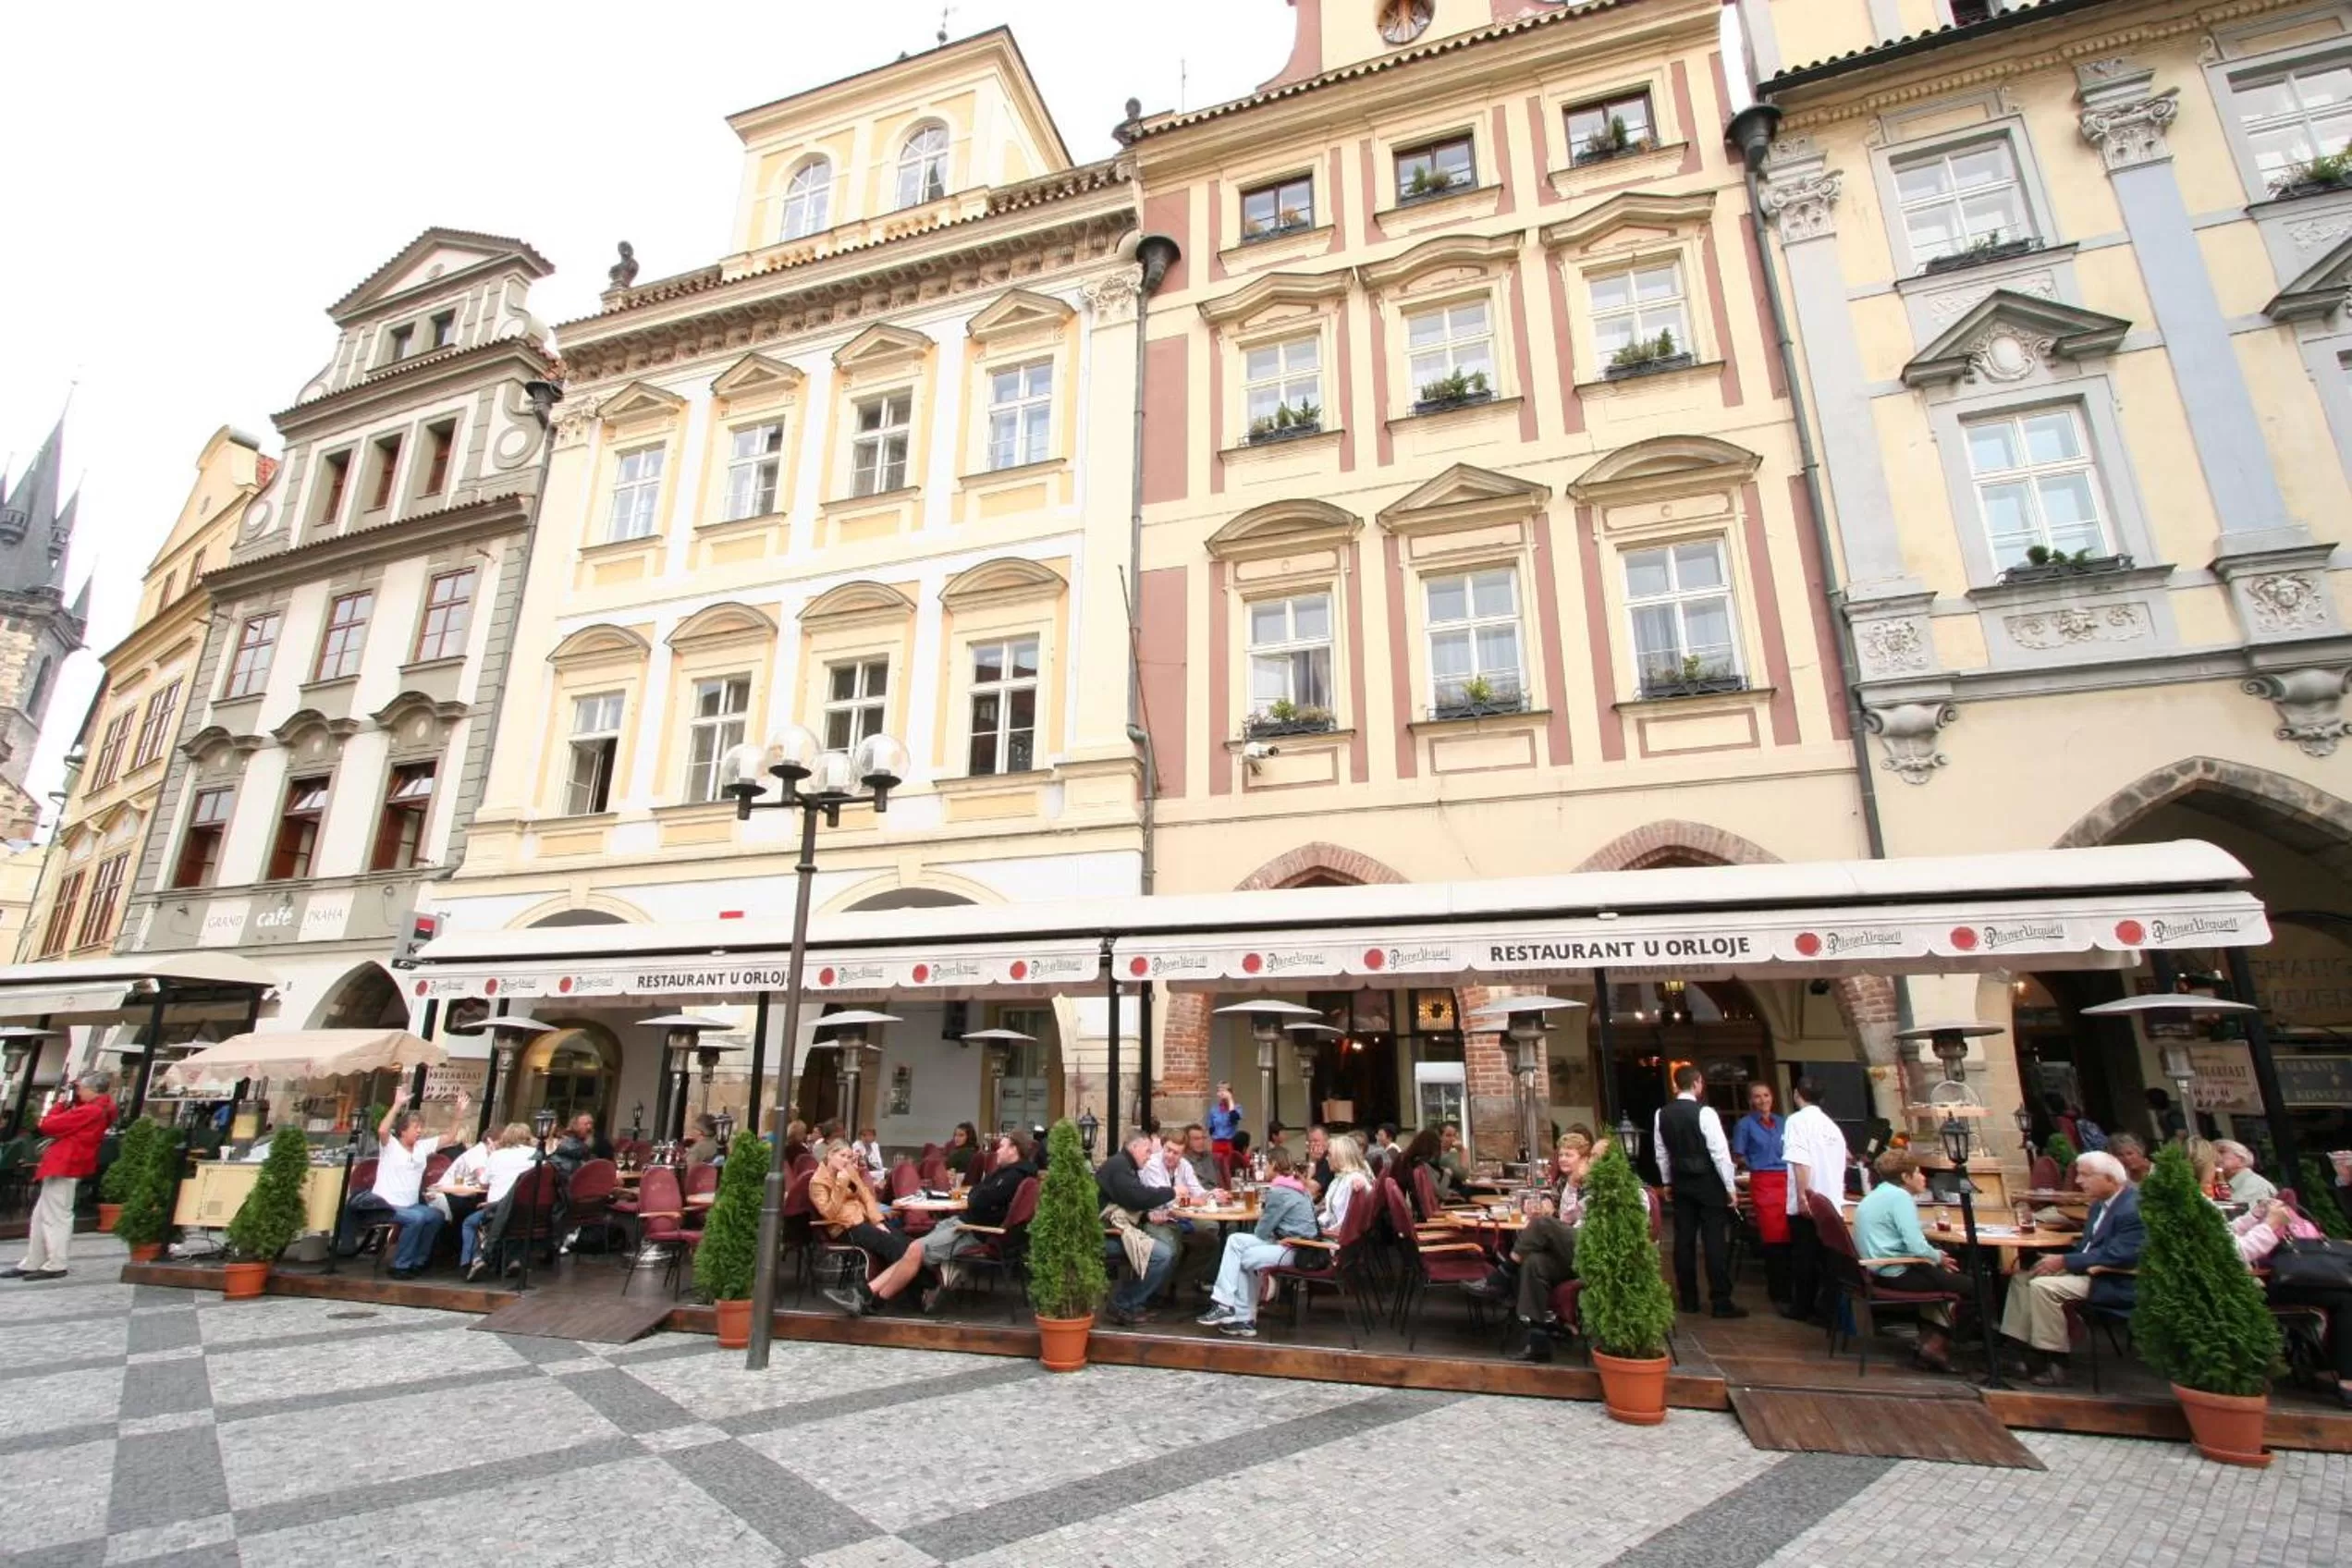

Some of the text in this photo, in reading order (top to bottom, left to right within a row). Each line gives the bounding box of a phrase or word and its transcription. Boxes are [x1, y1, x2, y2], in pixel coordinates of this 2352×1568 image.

[1984, 925, 2064, 950] Pilsner Urquell
[2151, 917, 2238, 944] Pilsner Urquell
[1489, 937, 1750, 962] RESTAURANT U ORLOJE
[1827, 932, 1864, 955] Pilsner
[637, 973, 726, 988] RESTAURANT
[729, 971, 740, 985] U
